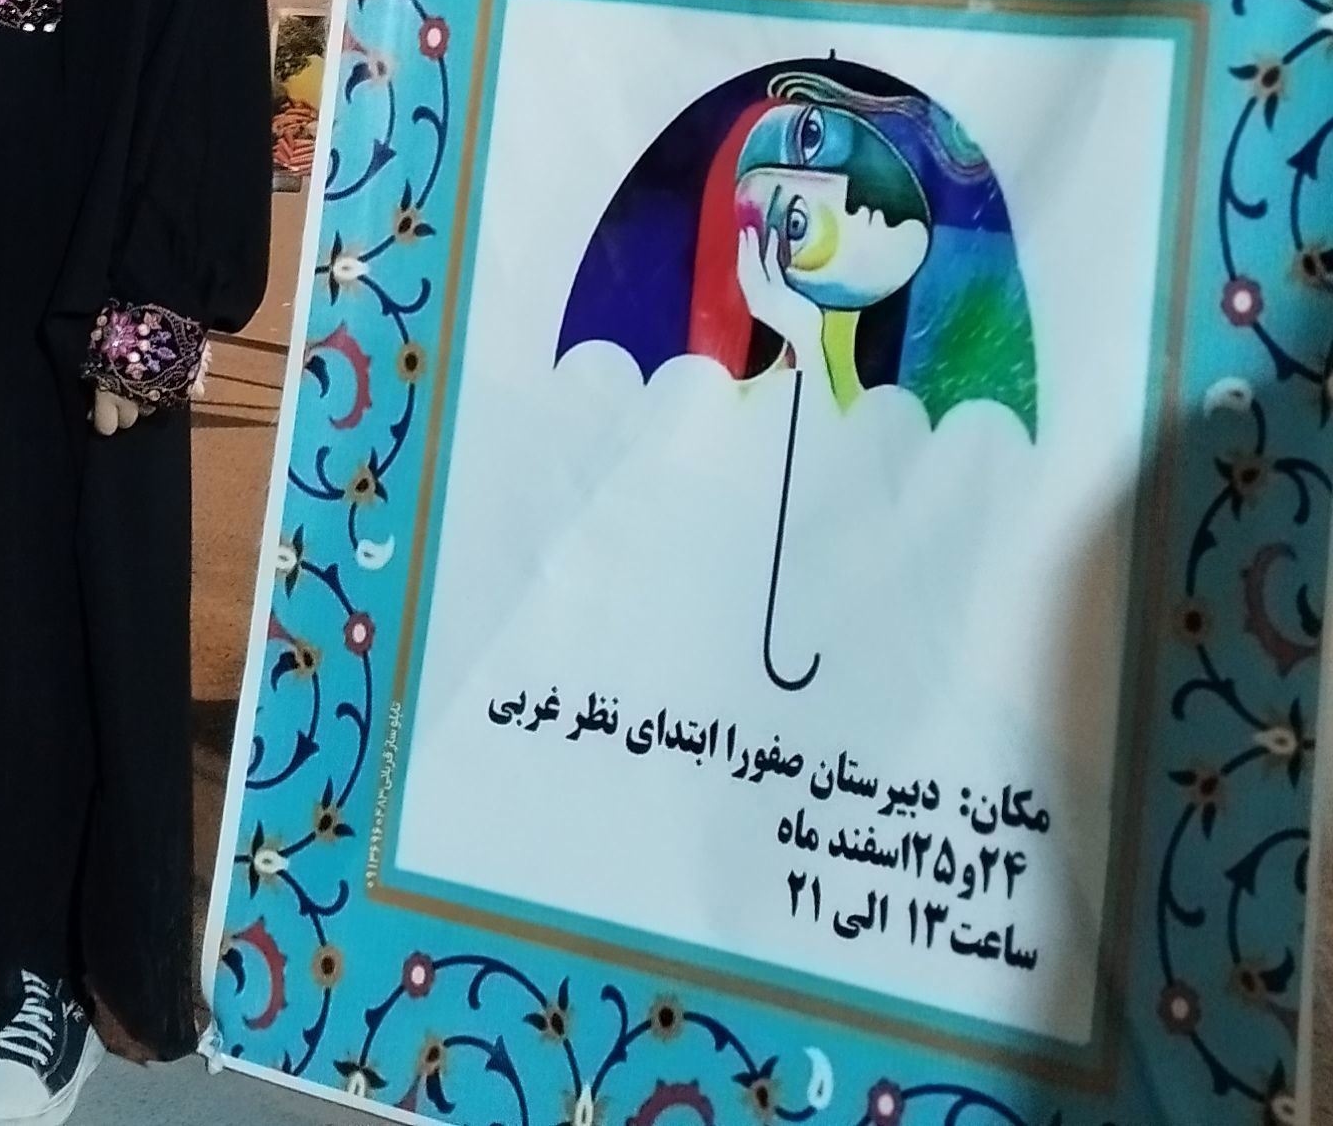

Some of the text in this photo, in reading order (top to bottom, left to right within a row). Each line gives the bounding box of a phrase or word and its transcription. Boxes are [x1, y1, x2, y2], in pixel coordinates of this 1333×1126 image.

[488, 685, 561, 731] غربی
[566, 691, 619, 741] نظر
[625, 708, 719, 766] ابتدای
[726, 723, 805, 783] صفورا
[810, 751, 941, 818] دبیرستان
[778, 807, 820, 852] ماه
[787, 869, 822, 922] ۲۱
[832, 890, 889, 940] الی
